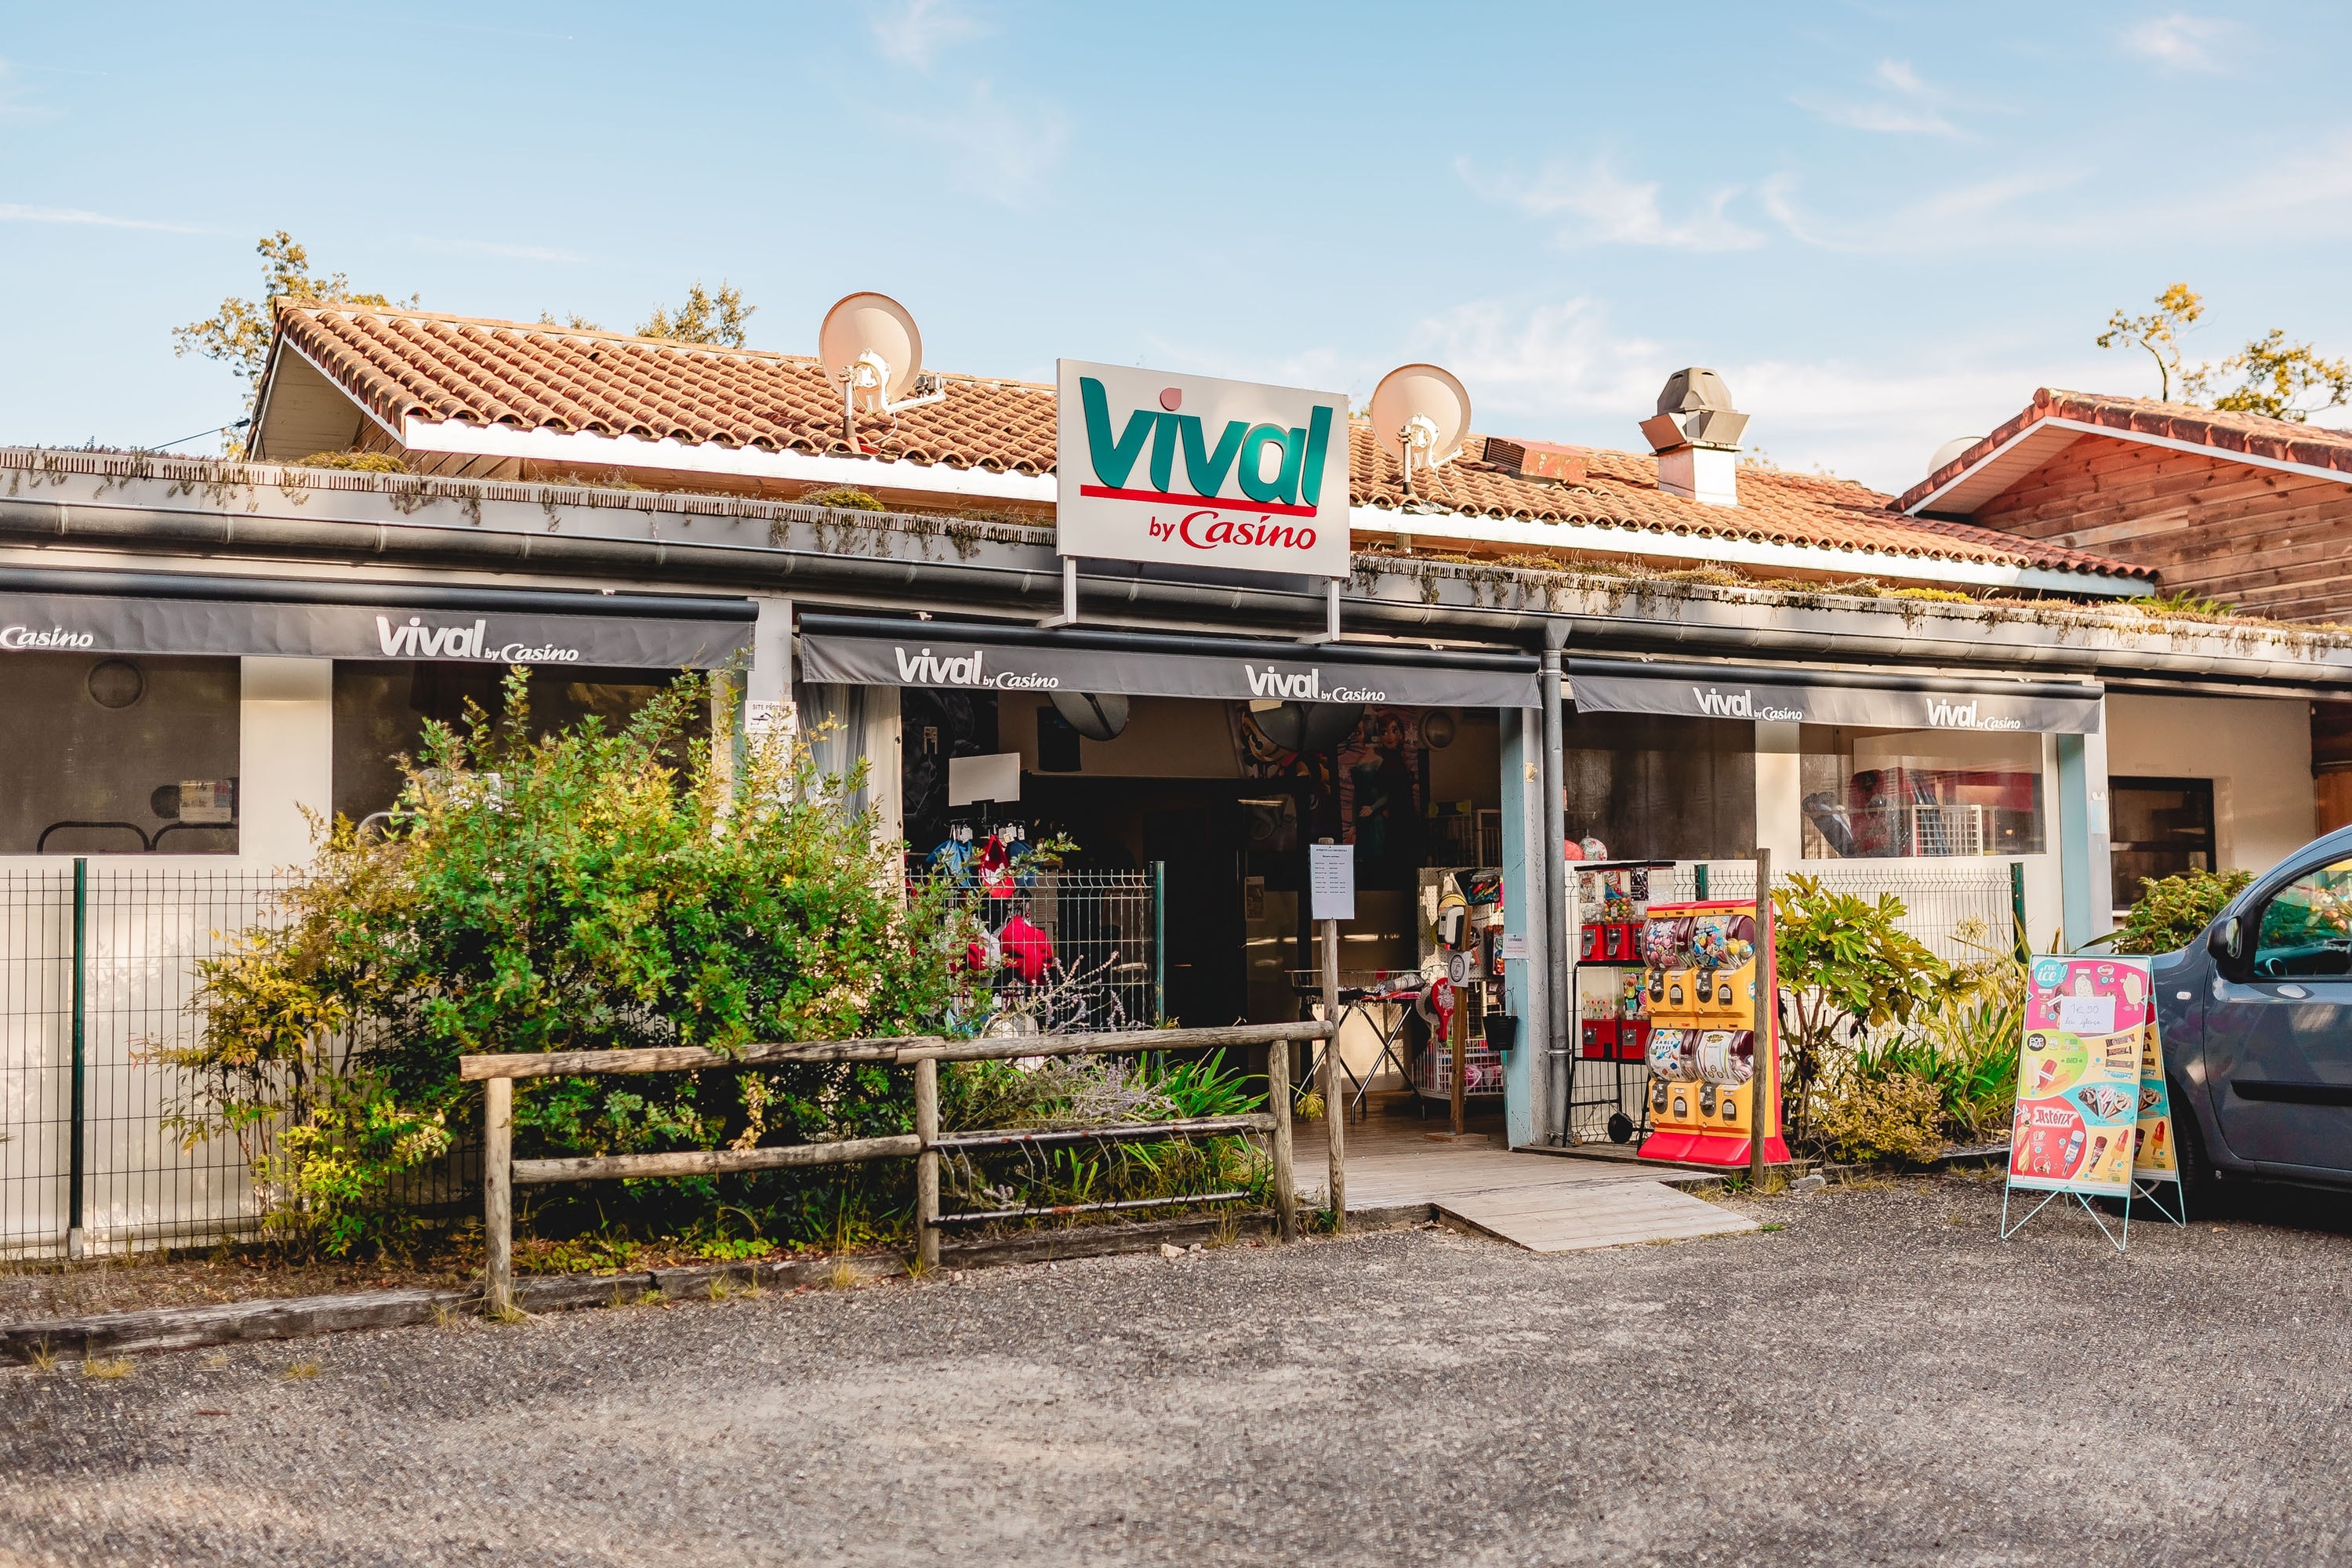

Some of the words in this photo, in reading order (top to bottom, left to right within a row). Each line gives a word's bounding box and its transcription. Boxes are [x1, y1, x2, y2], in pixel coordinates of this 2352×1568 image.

[1080, 376, 1333, 506] Vival
[1149, 516, 1175, 542] by
[1179, 510, 1316, 550] Casino
[0, 626, 94, 648] Casino
[376, 615, 486, 658] Vival
[484, 648, 500, 660] by
[500, 643, 579, 663] Casino
[895, 647, 983, 684] Vival
[982, 676, 996, 688] by
[996, 672, 1058, 689] Casino
[1244, 665, 1319, 699] Vival
[1321, 691, 1331, 701] by
[1332, 687, 1385, 702] Casino
[1692, 687, 1752, 717] Vival
[1754, 710, 1762, 719] by
[1762, 706, 1802, 721] Casino
[1926, 698, 1977, 728] Vival
[1976, 720, 1984, 729] by
[1984, 717, 2021, 731] Casino
